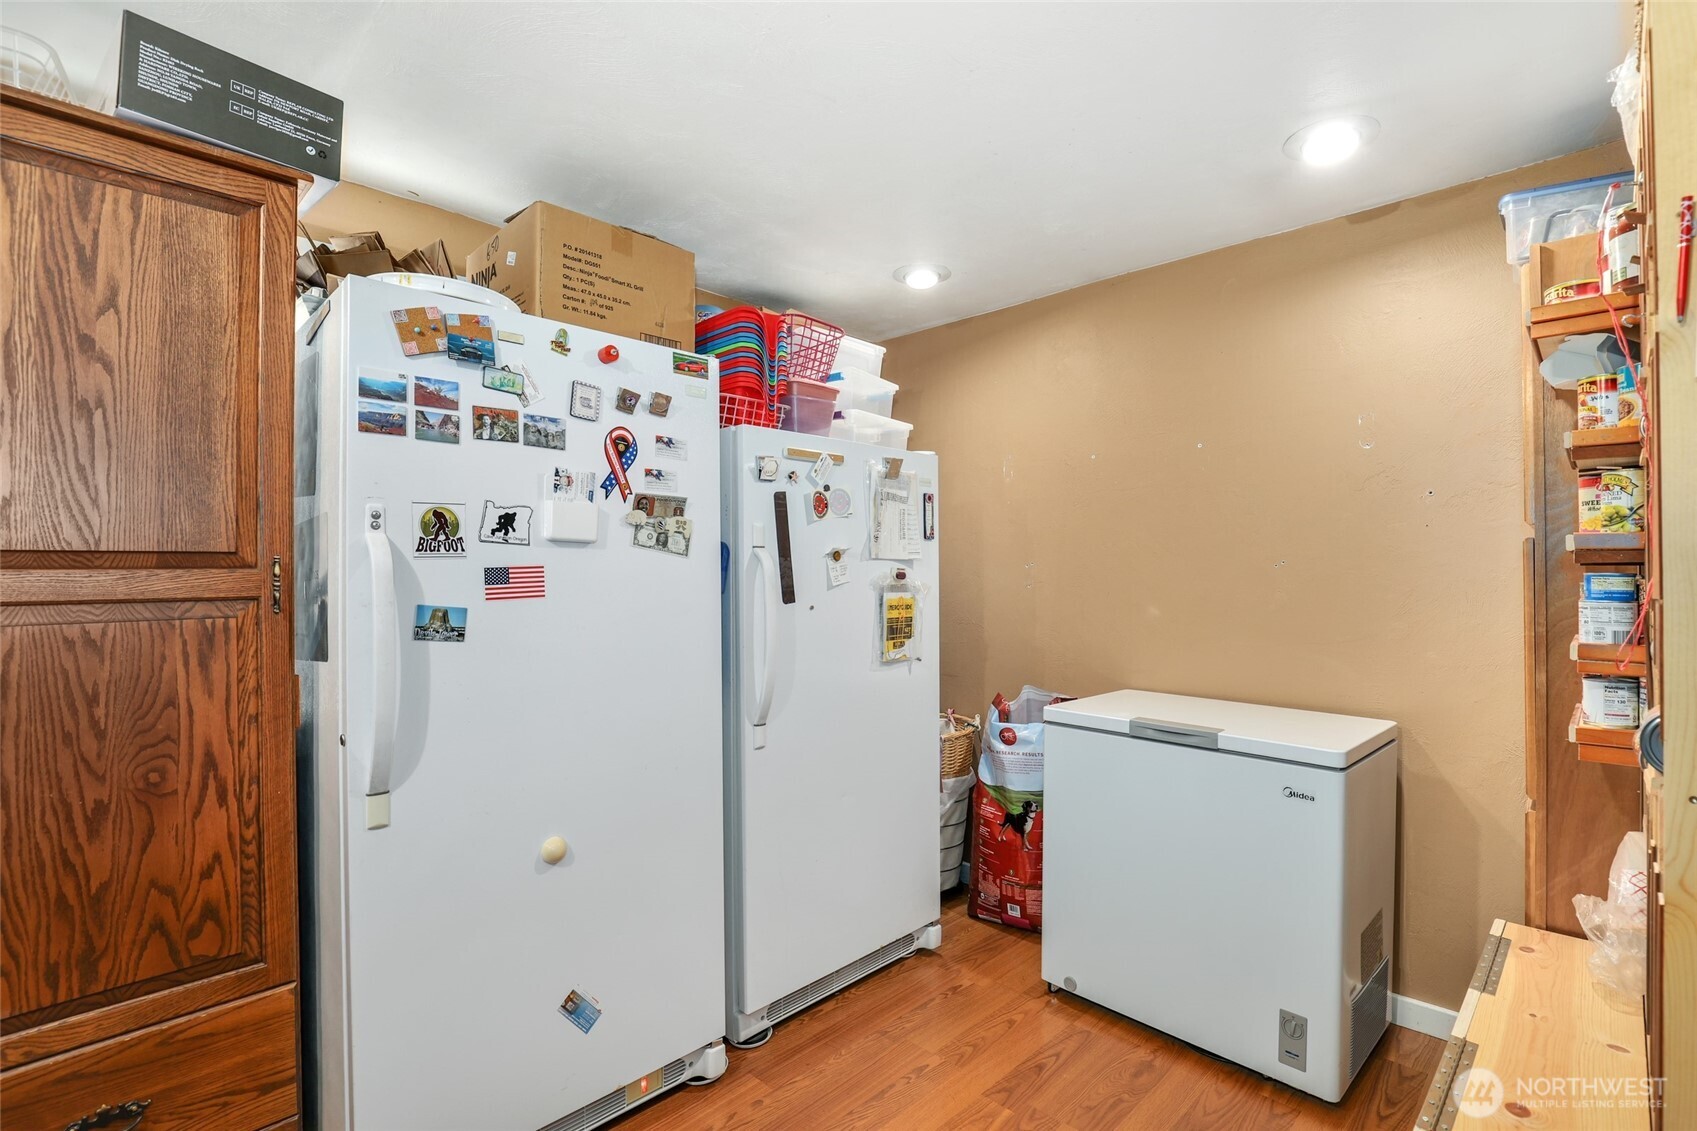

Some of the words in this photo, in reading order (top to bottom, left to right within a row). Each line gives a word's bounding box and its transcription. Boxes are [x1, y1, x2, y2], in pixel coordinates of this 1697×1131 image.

[563, 254, 583, 263] Model#:
[611, 278, 626, 286] Smart
[634, 284, 644, 292] Grill
[562, 294, 580, 303] Carton
[415, 536, 466, 552] BIGFOOT
[1286, 788, 1315, 801] Midea
